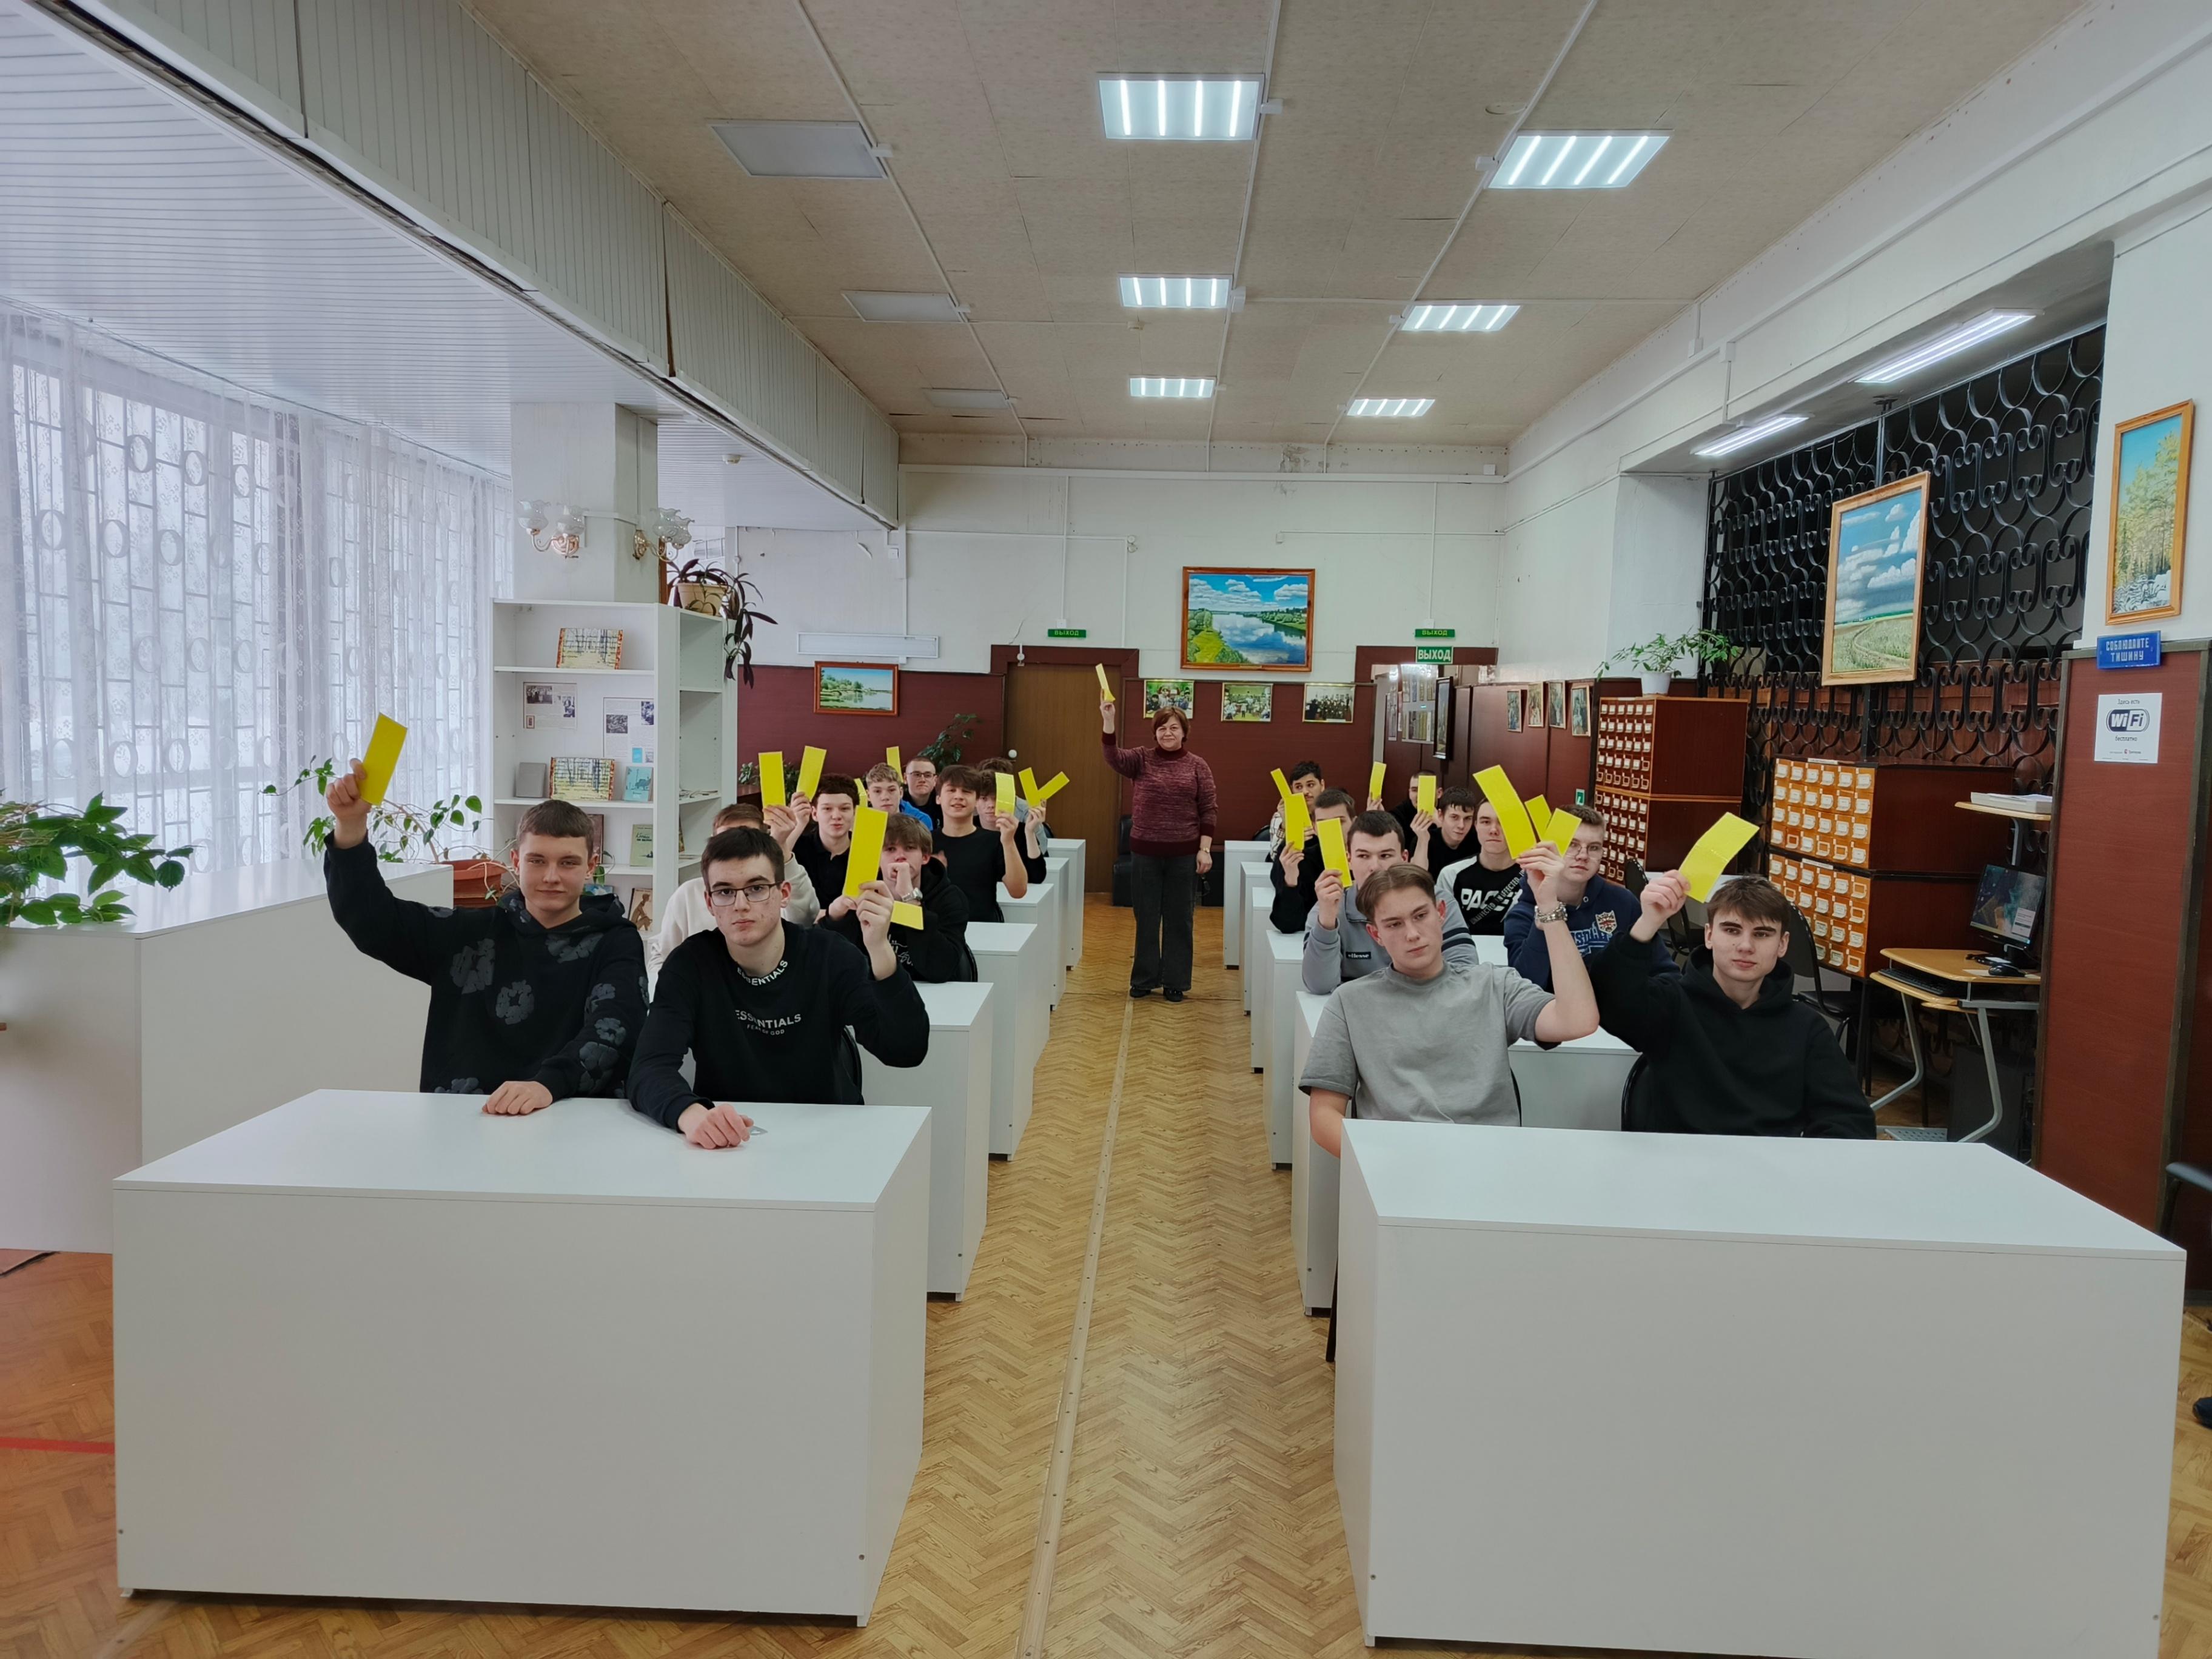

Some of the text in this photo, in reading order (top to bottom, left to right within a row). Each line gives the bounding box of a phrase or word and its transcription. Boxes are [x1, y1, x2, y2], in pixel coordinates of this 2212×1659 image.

[2105, 637, 2150, 651] СОБЛЮДАЙТЕ
[1418, 649, 1451, 662] ВЫХОД
[2110, 650, 2144, 663] ТИШИНУ
